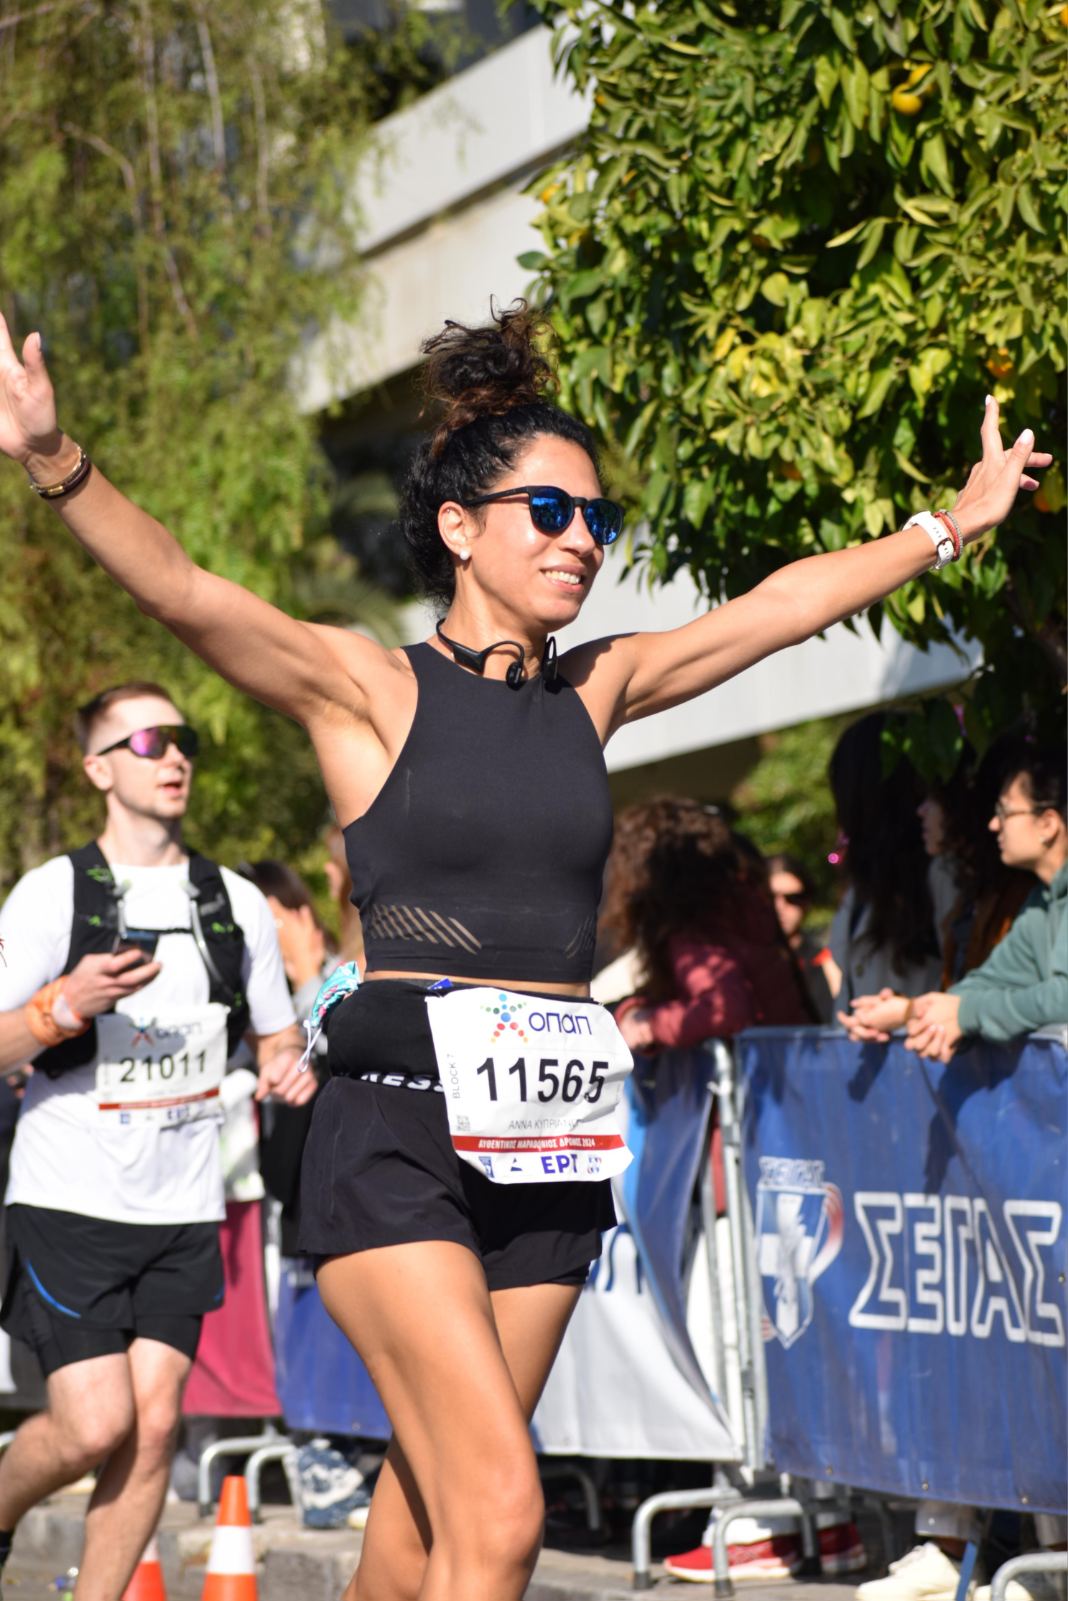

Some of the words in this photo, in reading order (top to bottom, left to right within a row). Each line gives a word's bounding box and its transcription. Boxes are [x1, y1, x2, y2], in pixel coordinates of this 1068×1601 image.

[120, 1050, 206, 1083] 21011
[449, 1062, 461, 1099] BLOCK
[476, 1057, 609, 1104] 11565
[848, 1191, 1066, 1348] ΣΕΓΑΣ
